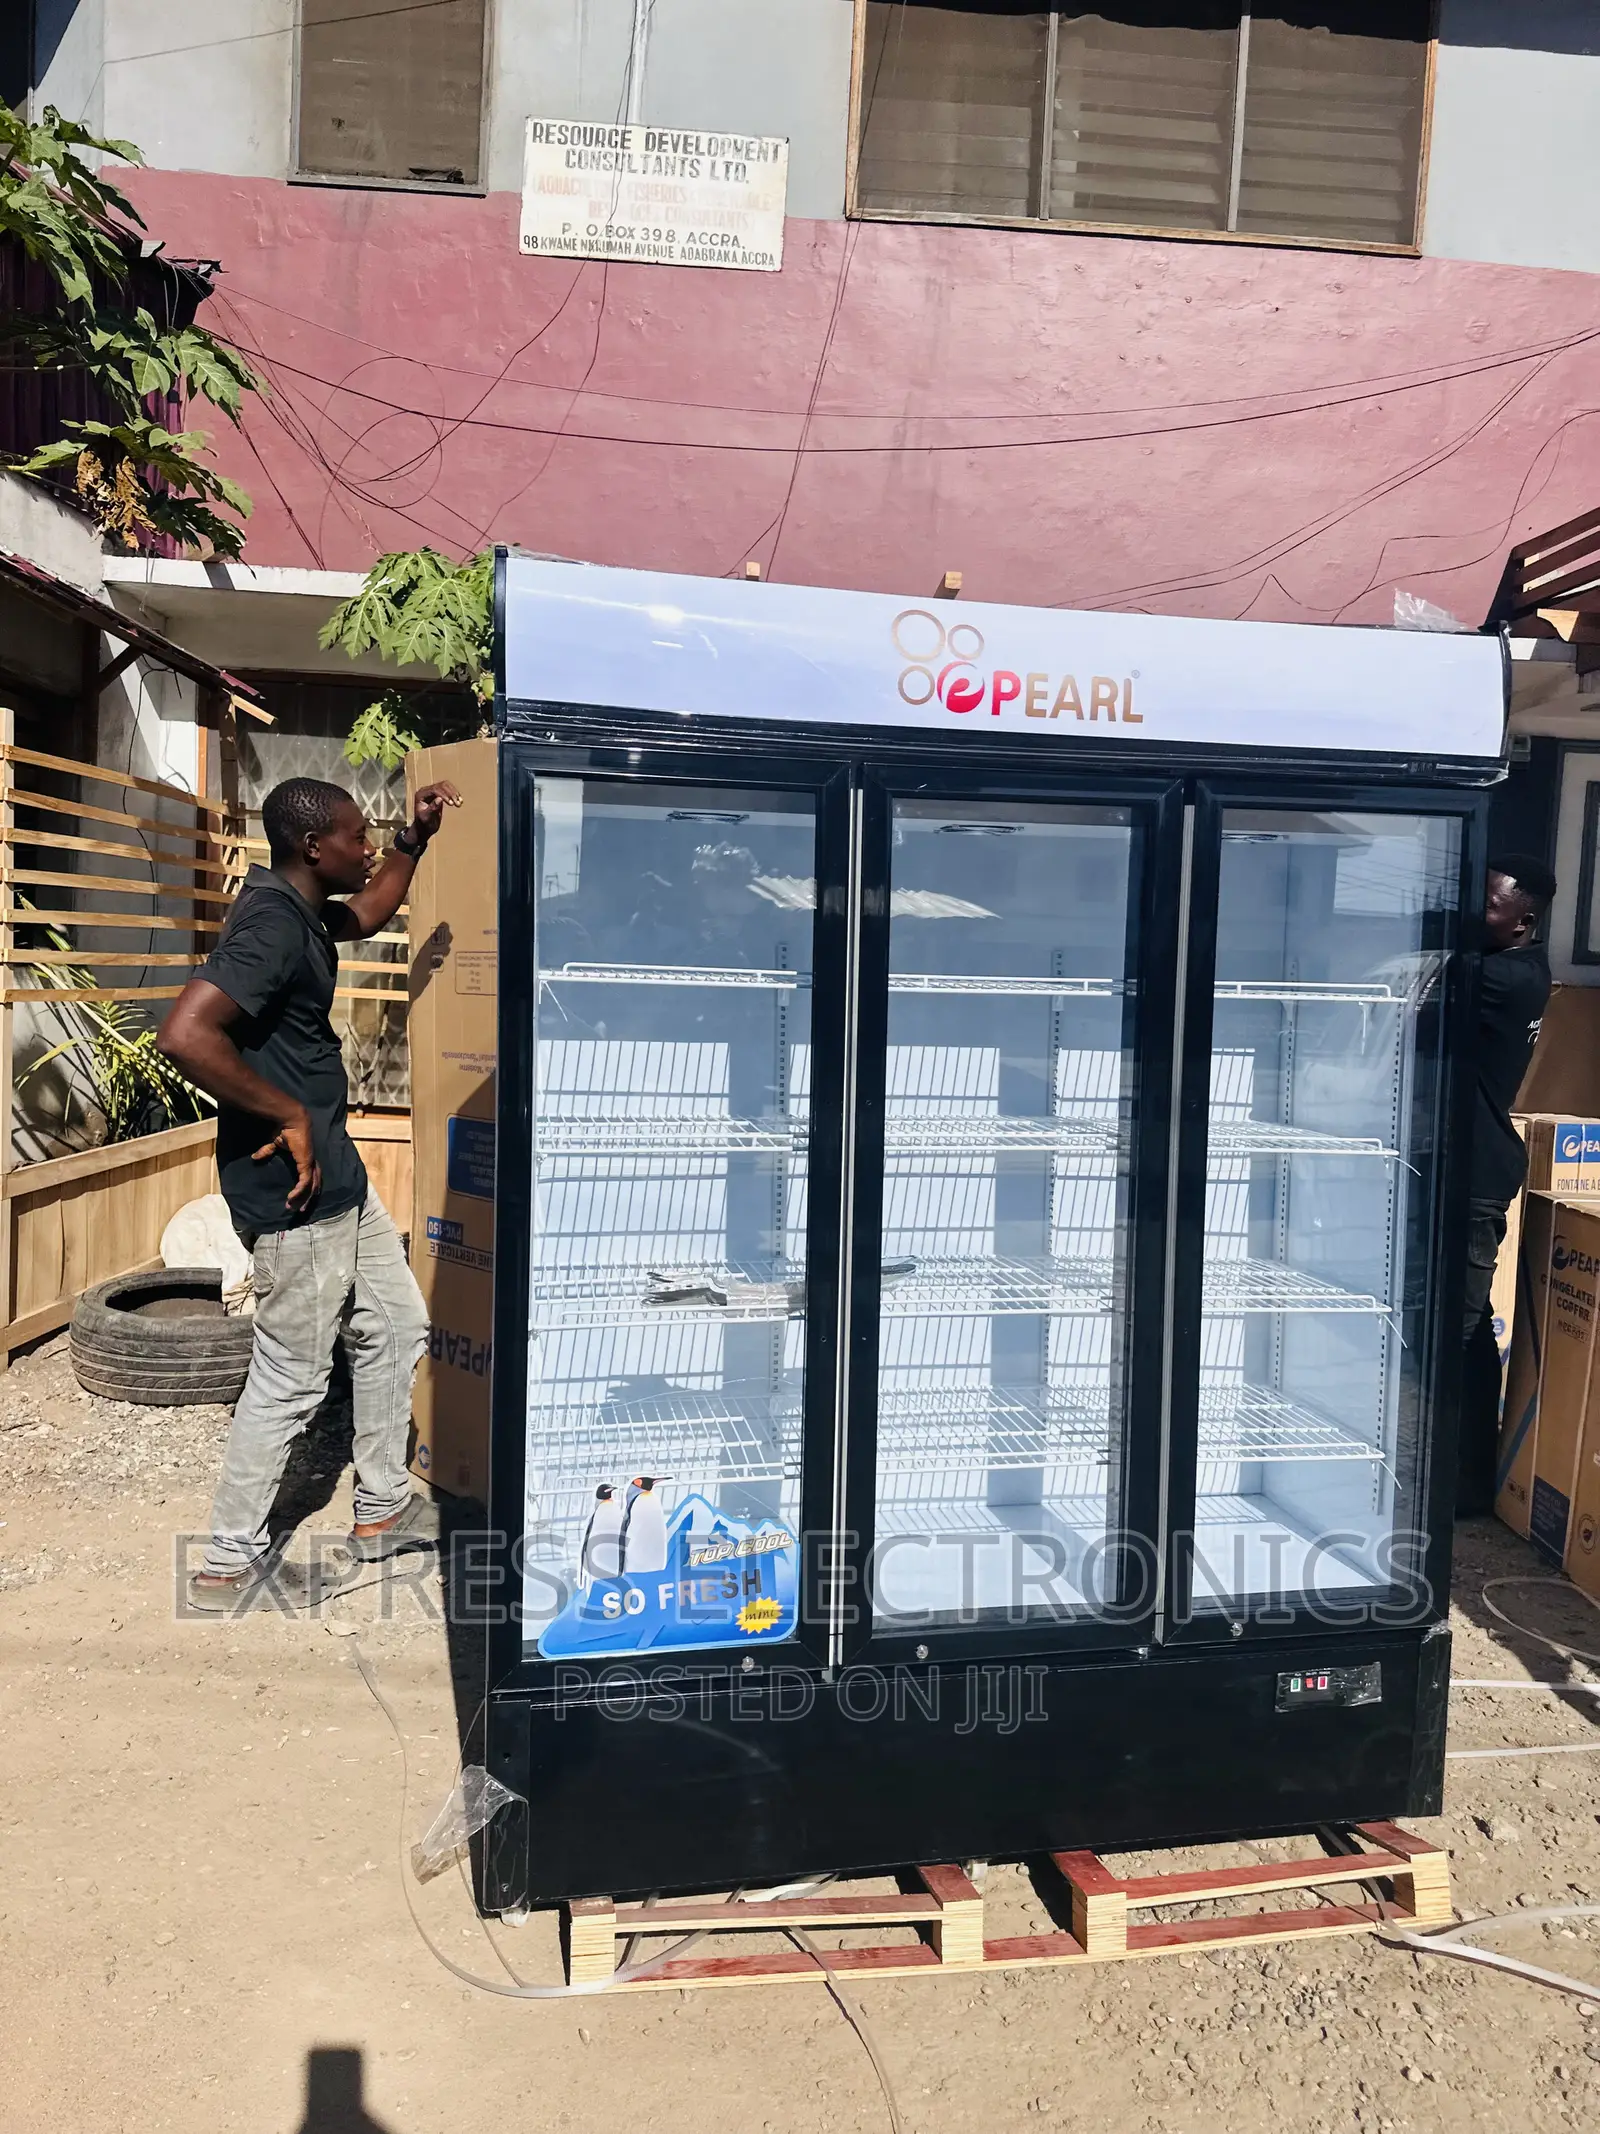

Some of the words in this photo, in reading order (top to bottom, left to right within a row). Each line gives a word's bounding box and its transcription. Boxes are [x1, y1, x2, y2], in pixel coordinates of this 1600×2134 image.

[532, 121, 632, 150] RESOURCE
[644, 131, 781, 163] DEVELOPMENT
[564, 148, 701, 179] CONSULTANTS
[709, 159, 750, 184] LTD.
[523, 234, 539, 249] 98
[540, 236, 579, 252] KWAME
[580, 239, 632, 255] NKRUMAH
[686, 231, 746, 249] ACCRA.
[689, 1541, 733, 1566] TOP
[735, 1532, 793, 1557] COOL
[602, 1588, 646, 1619] SO
[658, 1568, 761, 1610] FRESH
[744, 1608, 777, 1622] mini
